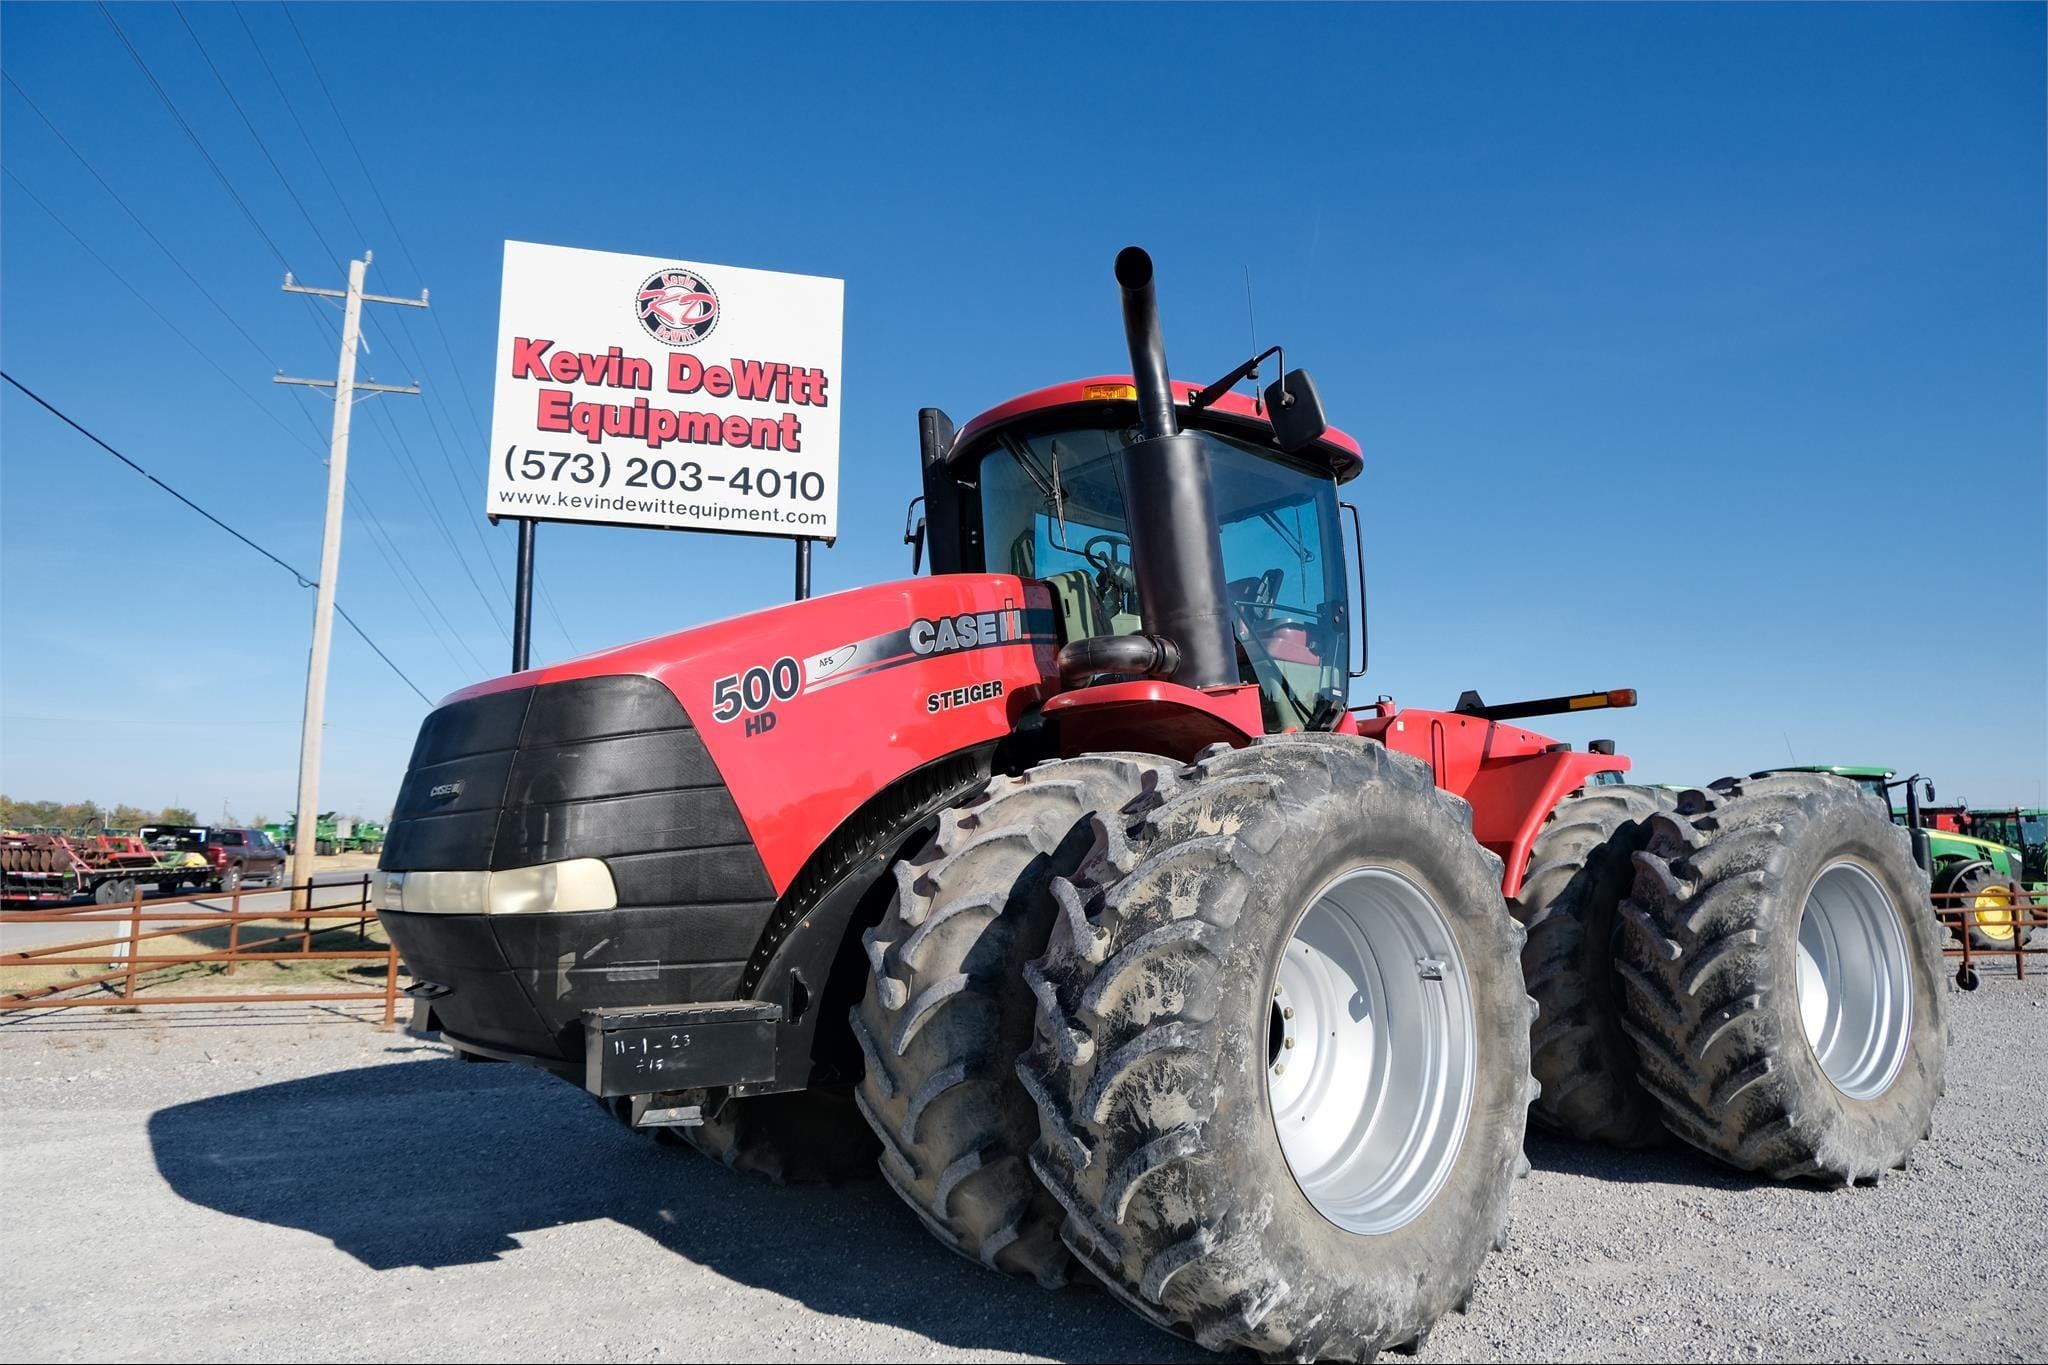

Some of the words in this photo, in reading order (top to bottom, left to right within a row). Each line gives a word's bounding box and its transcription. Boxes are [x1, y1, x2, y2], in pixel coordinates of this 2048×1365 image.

[512, 336, 653, 391] Kevin
[667, 351, 828, 407] DeWitt
[536, 388, 801, 453] Equipment
[504, 444, 612, 488] (573)
[624, 457, 825, 502] 203-4010
[499, 488, 827, 525] www.kevindewittequipment.com
[819, 656, 834, 668] AFS
[713, 655, 800, 723] 500
[927, 680, 1003, 712] STEIGER
[744, 710, 777, 738] HD
